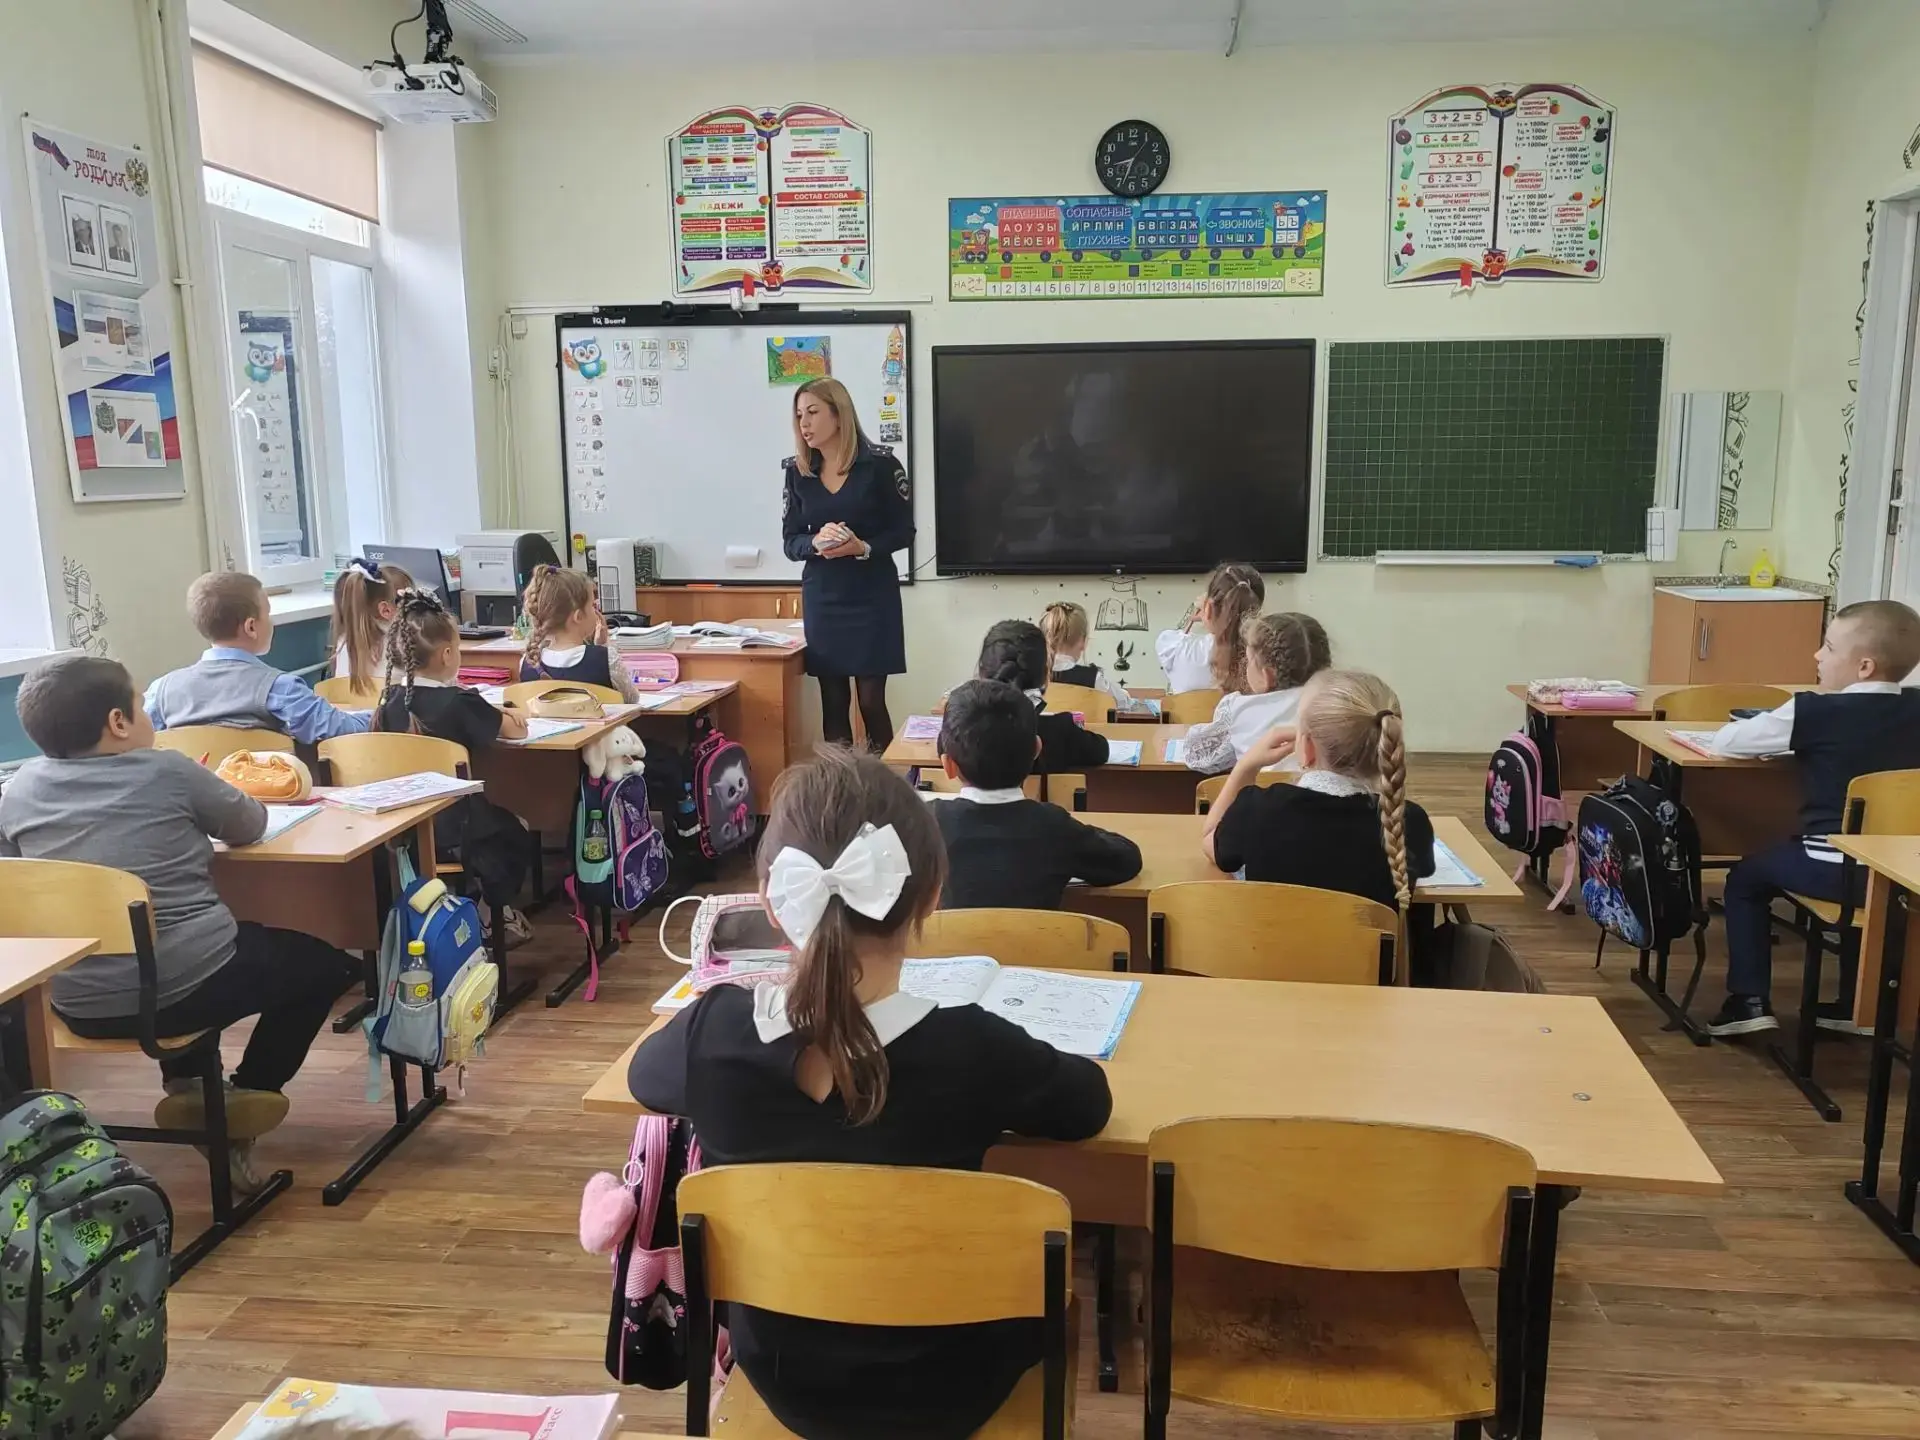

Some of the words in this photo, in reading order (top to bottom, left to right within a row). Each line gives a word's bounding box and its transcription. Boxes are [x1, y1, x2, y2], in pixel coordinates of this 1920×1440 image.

[1430, 113, 1437, 123] 3
[1452, 113, 1460, 122] 2
[1475, 112, 1482, 121] 5
[1117, 132, 1124, 142] 11
[1129, 128, 1138, 138] 12
[1423, 134, 1430, 143] 6
[1441, 134, 1448, 143] 4
[1462, 133, 1469, 142] 2
[1107, 143, 1116, 152] 10
[1152, 142, 1159, 152] 2
[1104, 155, 1111, 165] 9
[1438, 154, 1445, 164] 3
[1455, 154, 1462, 163] 2
[1476, 153, 1484, 163] 6
[1107, 167, 1114, 177] 8
[1150, 168, 1157, 177] 4
[1115, 177, 1122, 188] 7
[1141, 177, 1148, 188] 5
[1428, 174, 1435, 183] 6
[1445, 174, 1452, 183] 2
[1466, 173, 1473, 182] 3
[1128, 181, 1135, 191] 6
[699, 202, 744, 210] ПАДЕЖИ
[1003, 208, 1056, 218] ГЛАСНЫЕ
[1066, 207, 1131, 218] СОГЛАСНЫЕ
[1219, 219, 1264, 229] ЗВОНКИЕ
[1078, 236, 1120, 246] ГЛУХИЕ
[992, 285, 997, 293] 1
[1005, 285, 1012, 293] 2
[1020, 285, 1026, 293] 3
[1034, 284, 1041, 293] 4
[1049, 284, 1056, 292] 5
[1064, 284, 1070, 292] 6
[1079, 283, 1085, 292] 7
[1094, 283, 1100, 292] 8
[1109, 283, 1115, 292] 9
[1122, 283, 1132, 292] 10
[1137, 282, 1147, 291] 11
[1151, 282, 1162, 291] 12
[1166, 282, 1177, 291] 13
[1181, 282, 1192, 291] 14
[1196, 281, 1207, 291] 15
[1211, 281, 1222, 291] 16
[1226, 281, 1237, 290] 17
[1241, 281, 1252, 290] 18
[1256, 281, 1267, 290] 19
[1271, 280, 1282, 290] 20
[370, 552, 385, 560] acer
